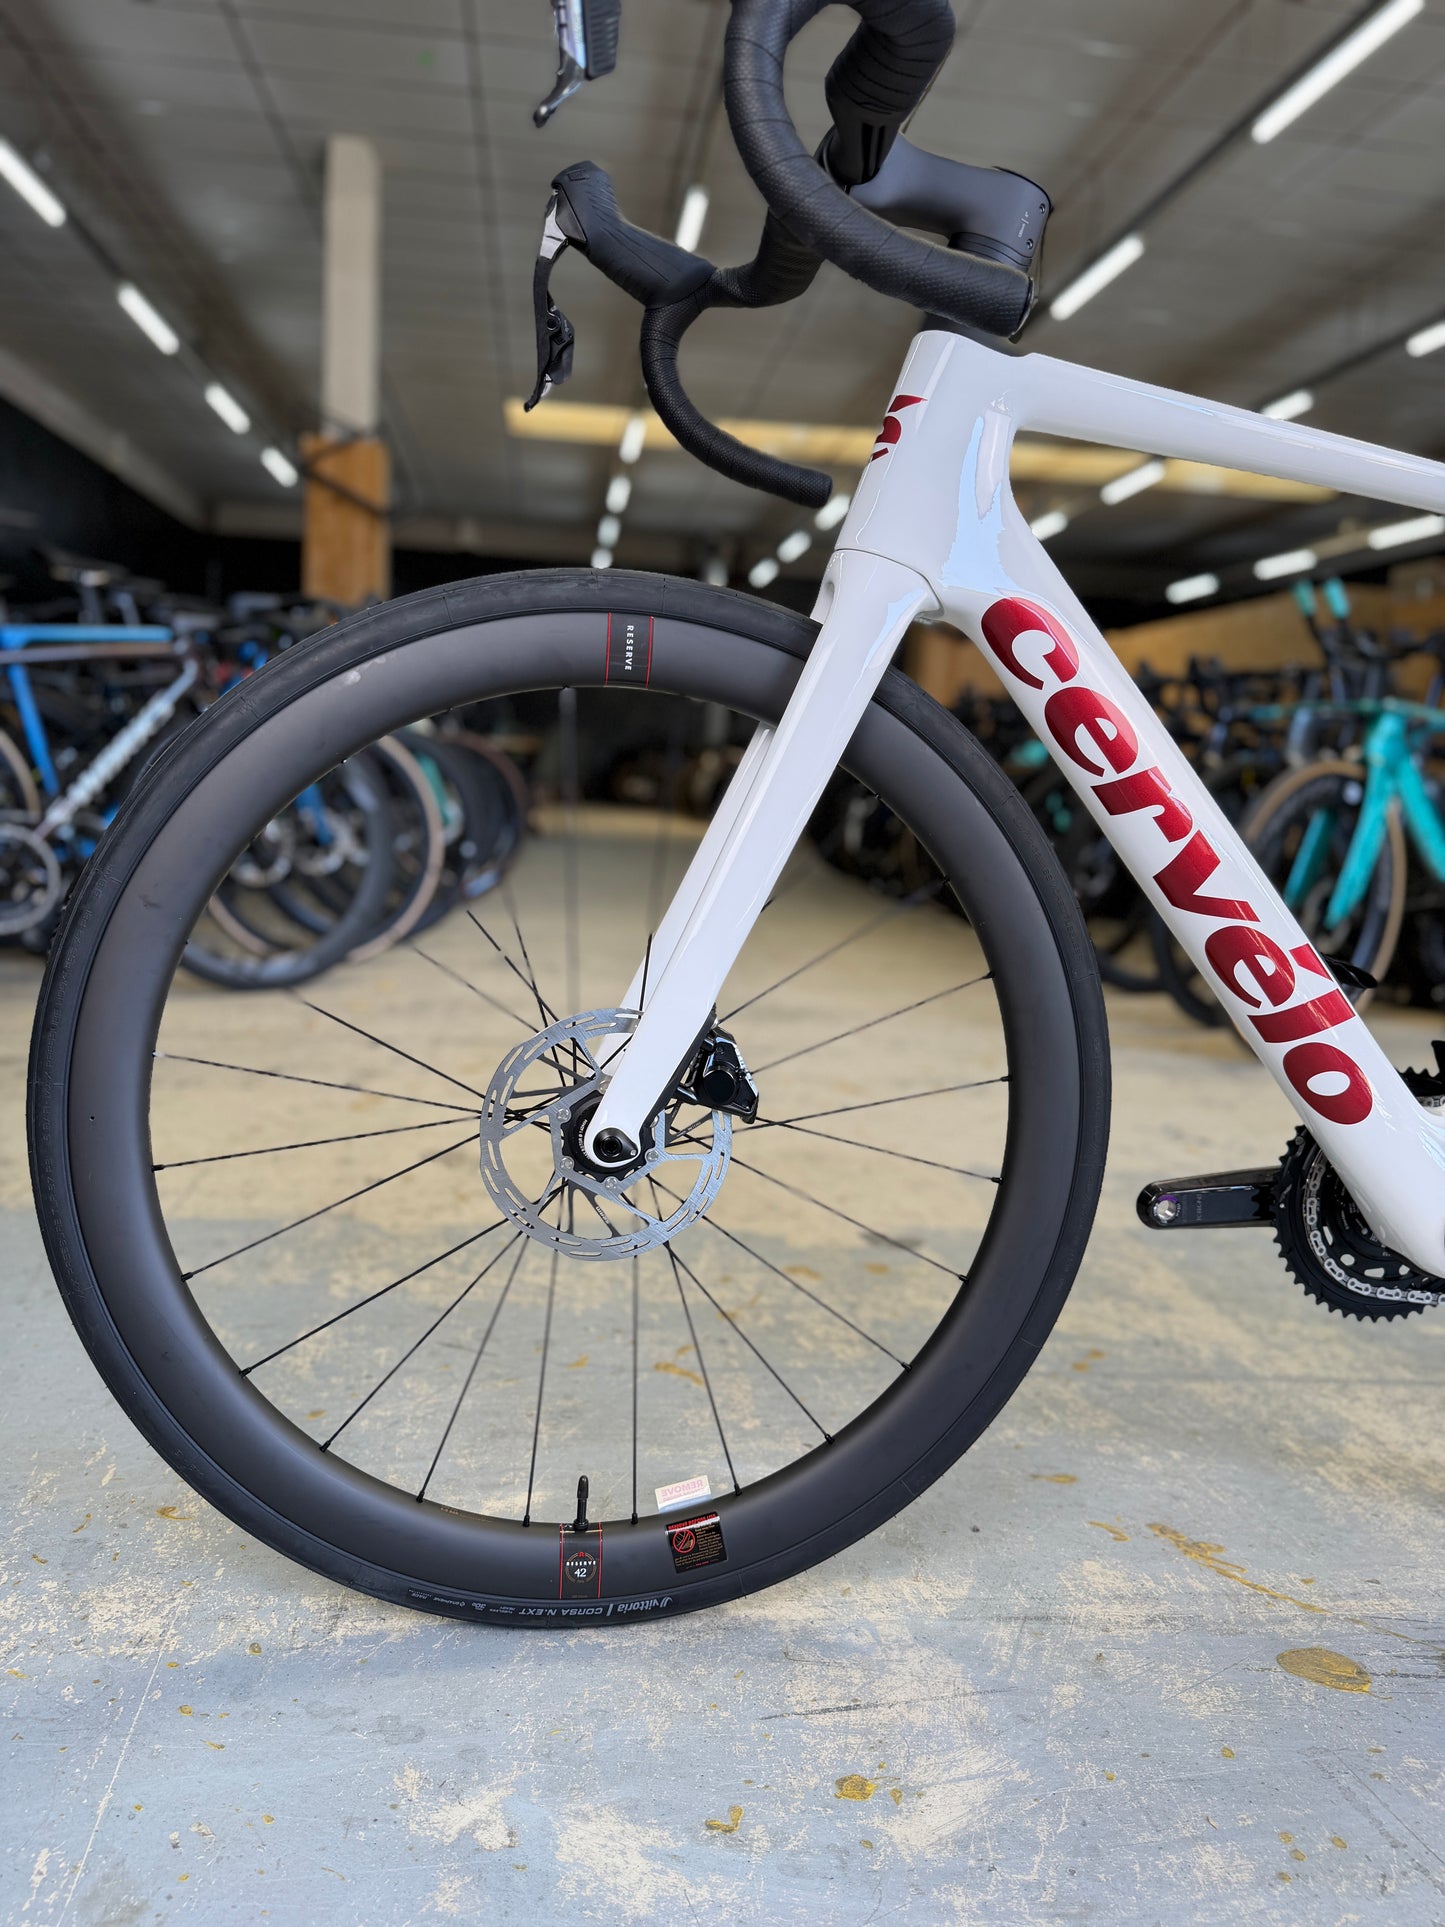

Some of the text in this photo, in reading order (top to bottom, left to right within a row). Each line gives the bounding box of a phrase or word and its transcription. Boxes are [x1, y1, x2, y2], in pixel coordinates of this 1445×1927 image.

[624, 625, 635, 671] RESERVE
[981, 597, 1373, 1125] cervélo
[574, 1567, 587, 1578] 42
[518, 1599, 660, 1616] vittoria CORSA N.EXT
